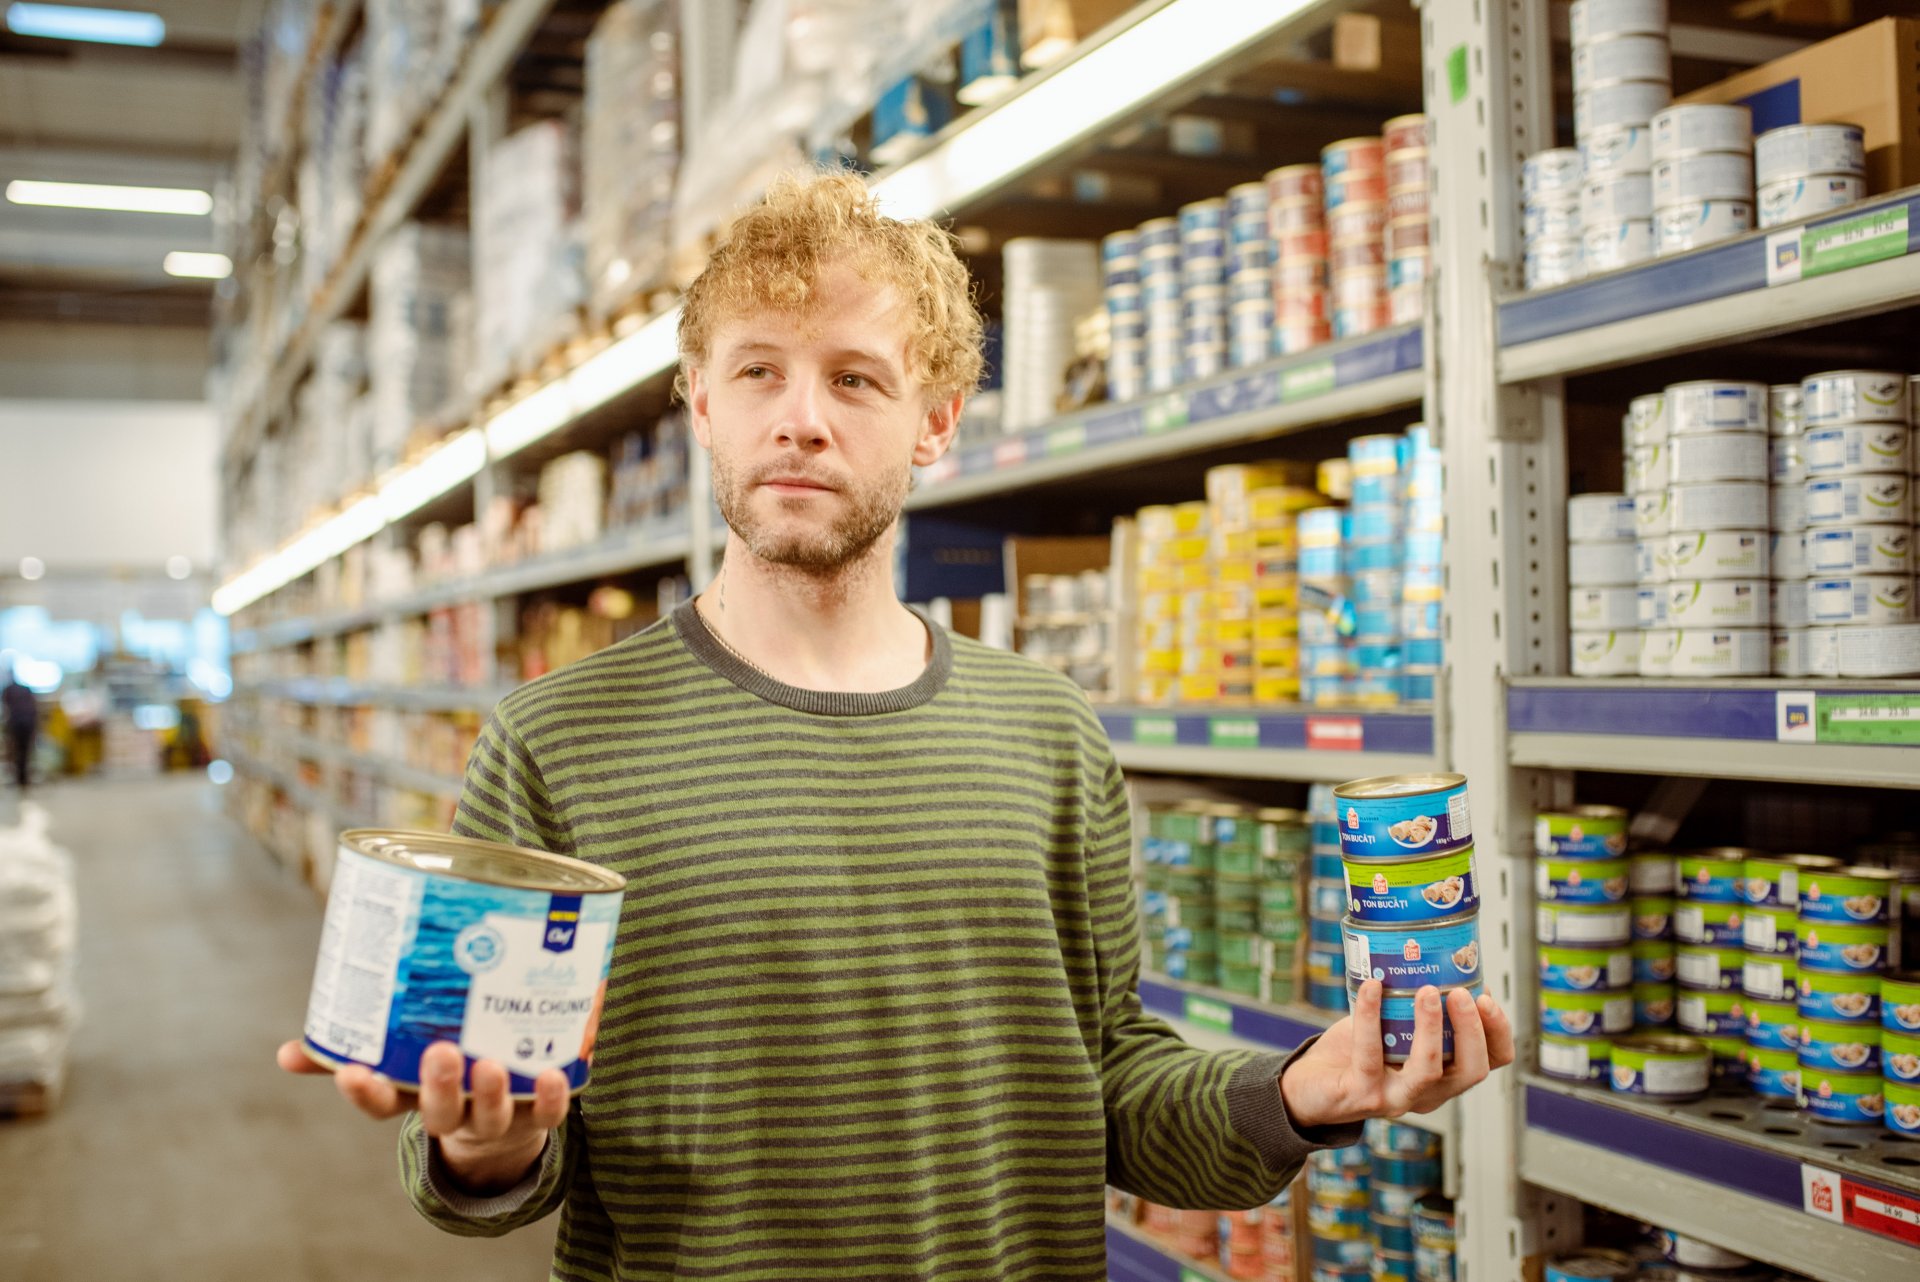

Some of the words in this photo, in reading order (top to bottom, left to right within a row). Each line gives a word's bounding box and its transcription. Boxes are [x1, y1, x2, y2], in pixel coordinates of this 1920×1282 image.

[1362, 899, 1377, 908] TON
[1388, 966, 1406, 975] TON
[483, 996, 532, 1014] TUNA
[1400, 1032, 1414, 1041] TO
